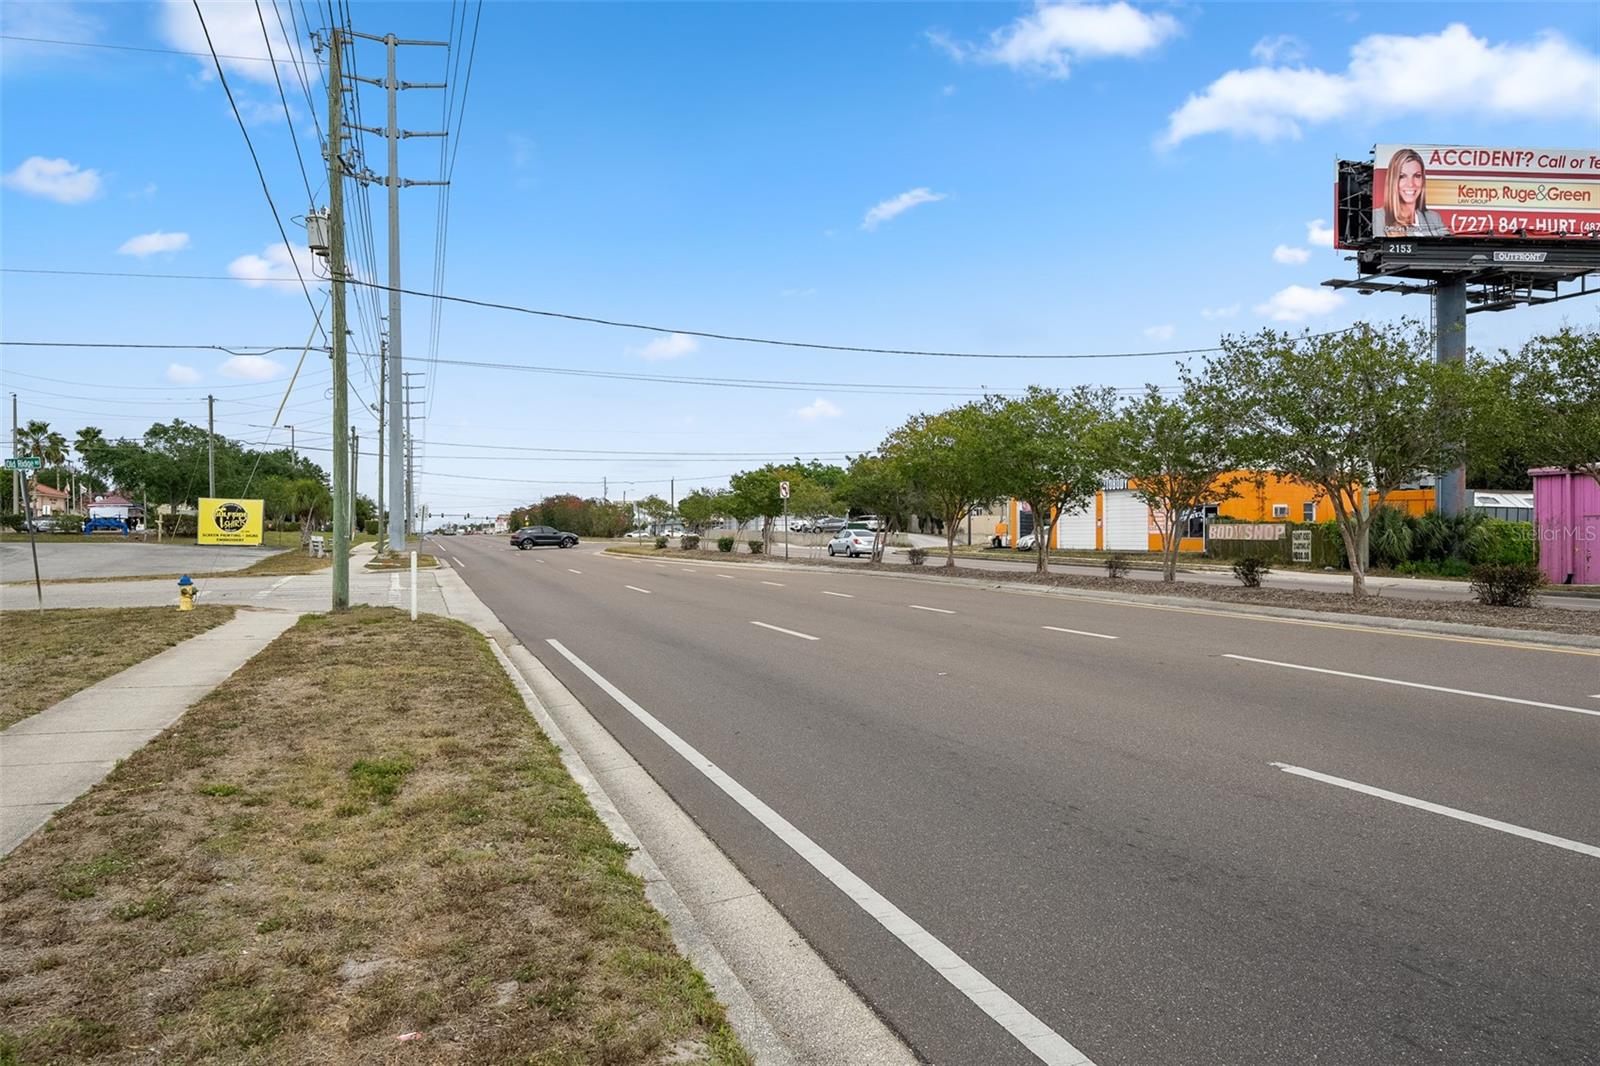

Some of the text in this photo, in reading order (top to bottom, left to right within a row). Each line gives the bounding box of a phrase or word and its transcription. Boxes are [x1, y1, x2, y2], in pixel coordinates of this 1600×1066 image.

[1429, 149, 1534, 167] ACCIDENT?
[1537, 154, 1566, 168] Call
[1570, 158, 1585, 169] or
[1458, 184, 1500, 202] Kemp,
[1451, 213, 1494, 232] (727)
[1498, 216, 1577, 234] 847-HURT
[1389, 244, 1412, 254] 2153
[1498, 252, 1541, 261] OUTFRONT
[1209, 524, 1285, 540] BODY SHOP
